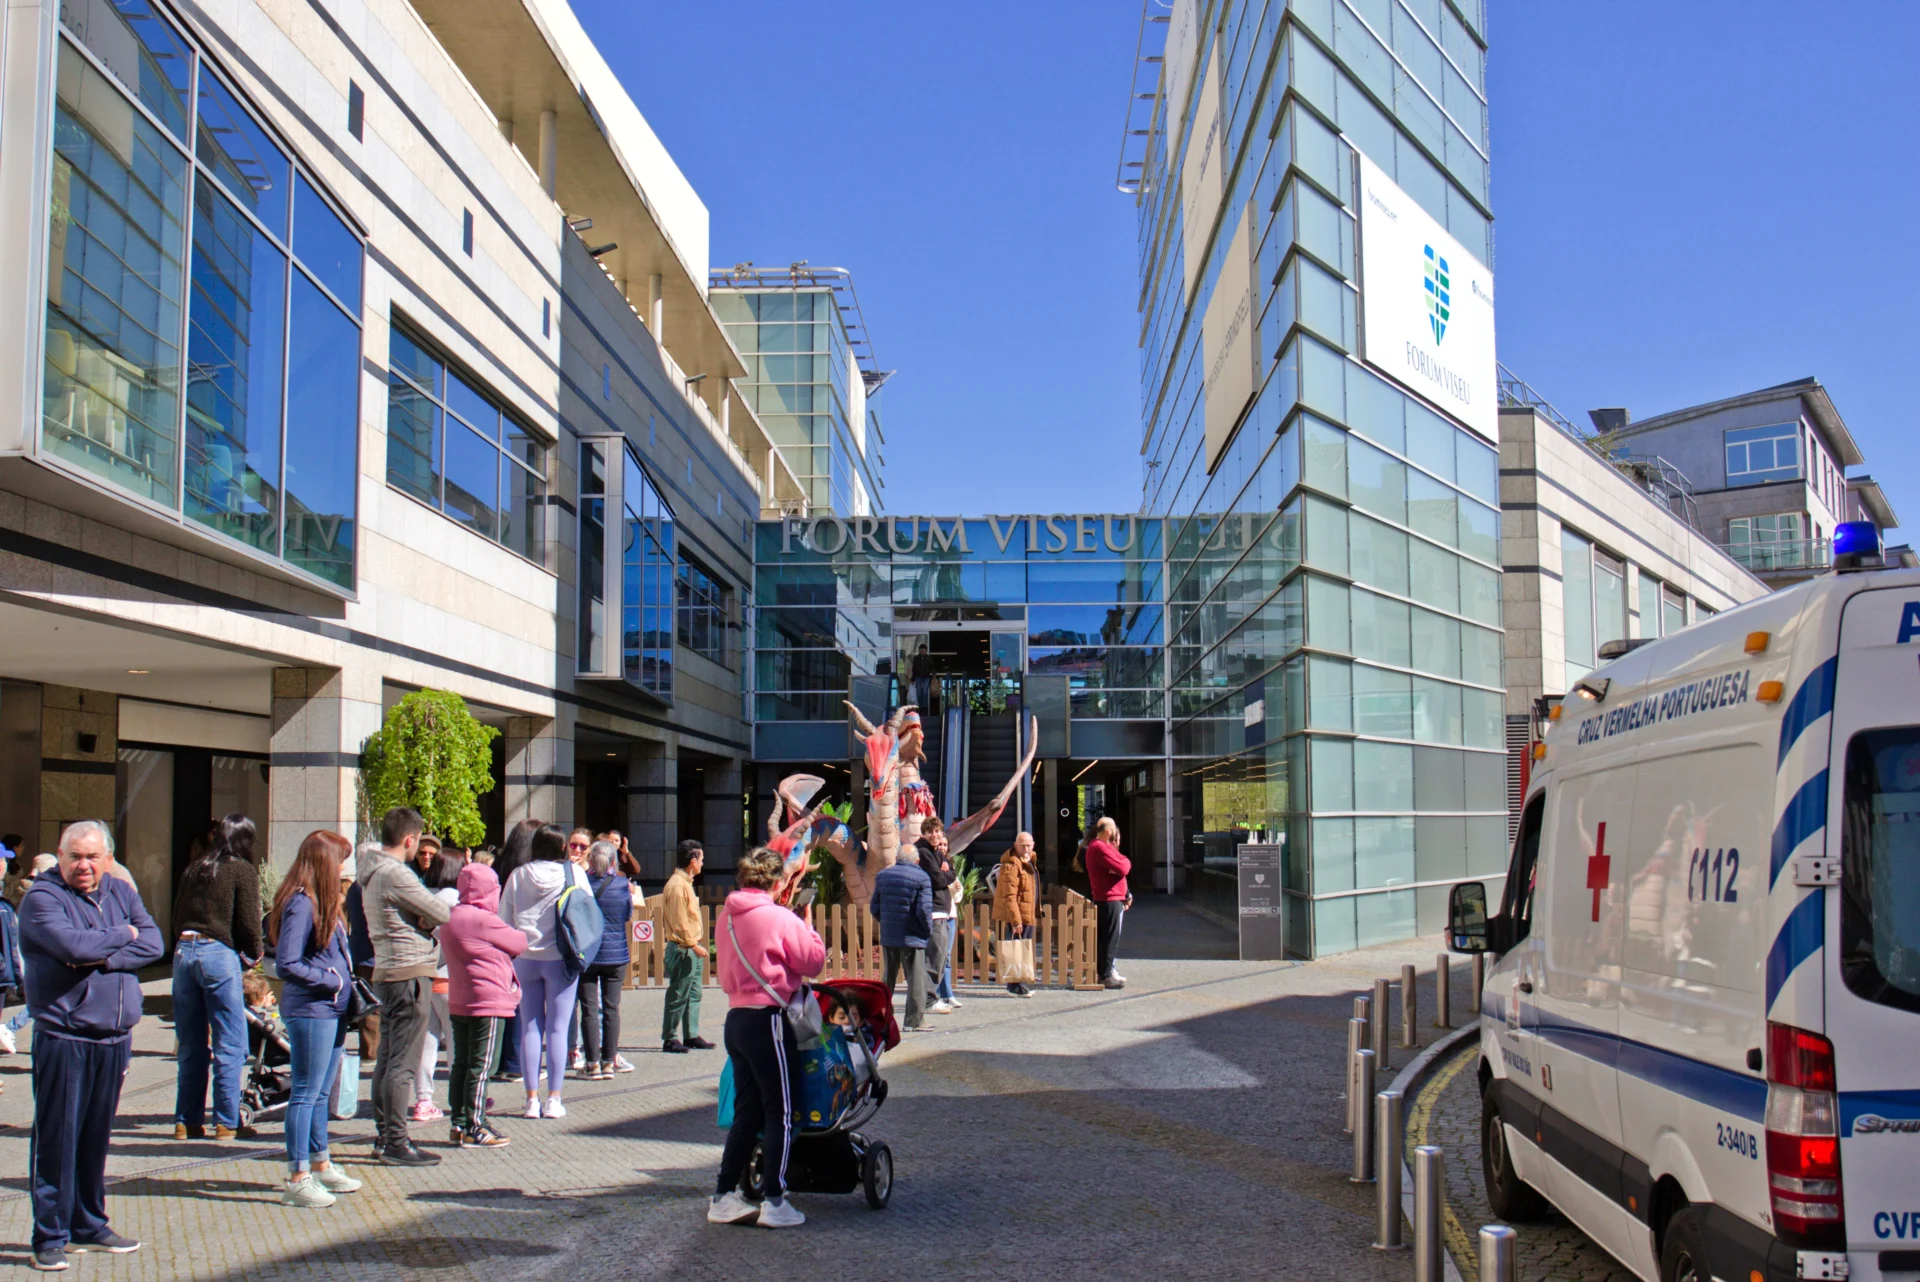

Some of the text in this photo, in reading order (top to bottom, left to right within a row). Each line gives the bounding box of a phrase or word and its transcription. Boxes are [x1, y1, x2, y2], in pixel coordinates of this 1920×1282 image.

[1406, 340, 1470, 405] FORUM VISEU
[779, 513, 1138, 554] FORUM VISEU
[1577, 669, 1751, 746] CRUZ VERMELHA PORTUGUESA
[1716, 1121, 1758, 1161] 2-340/B
